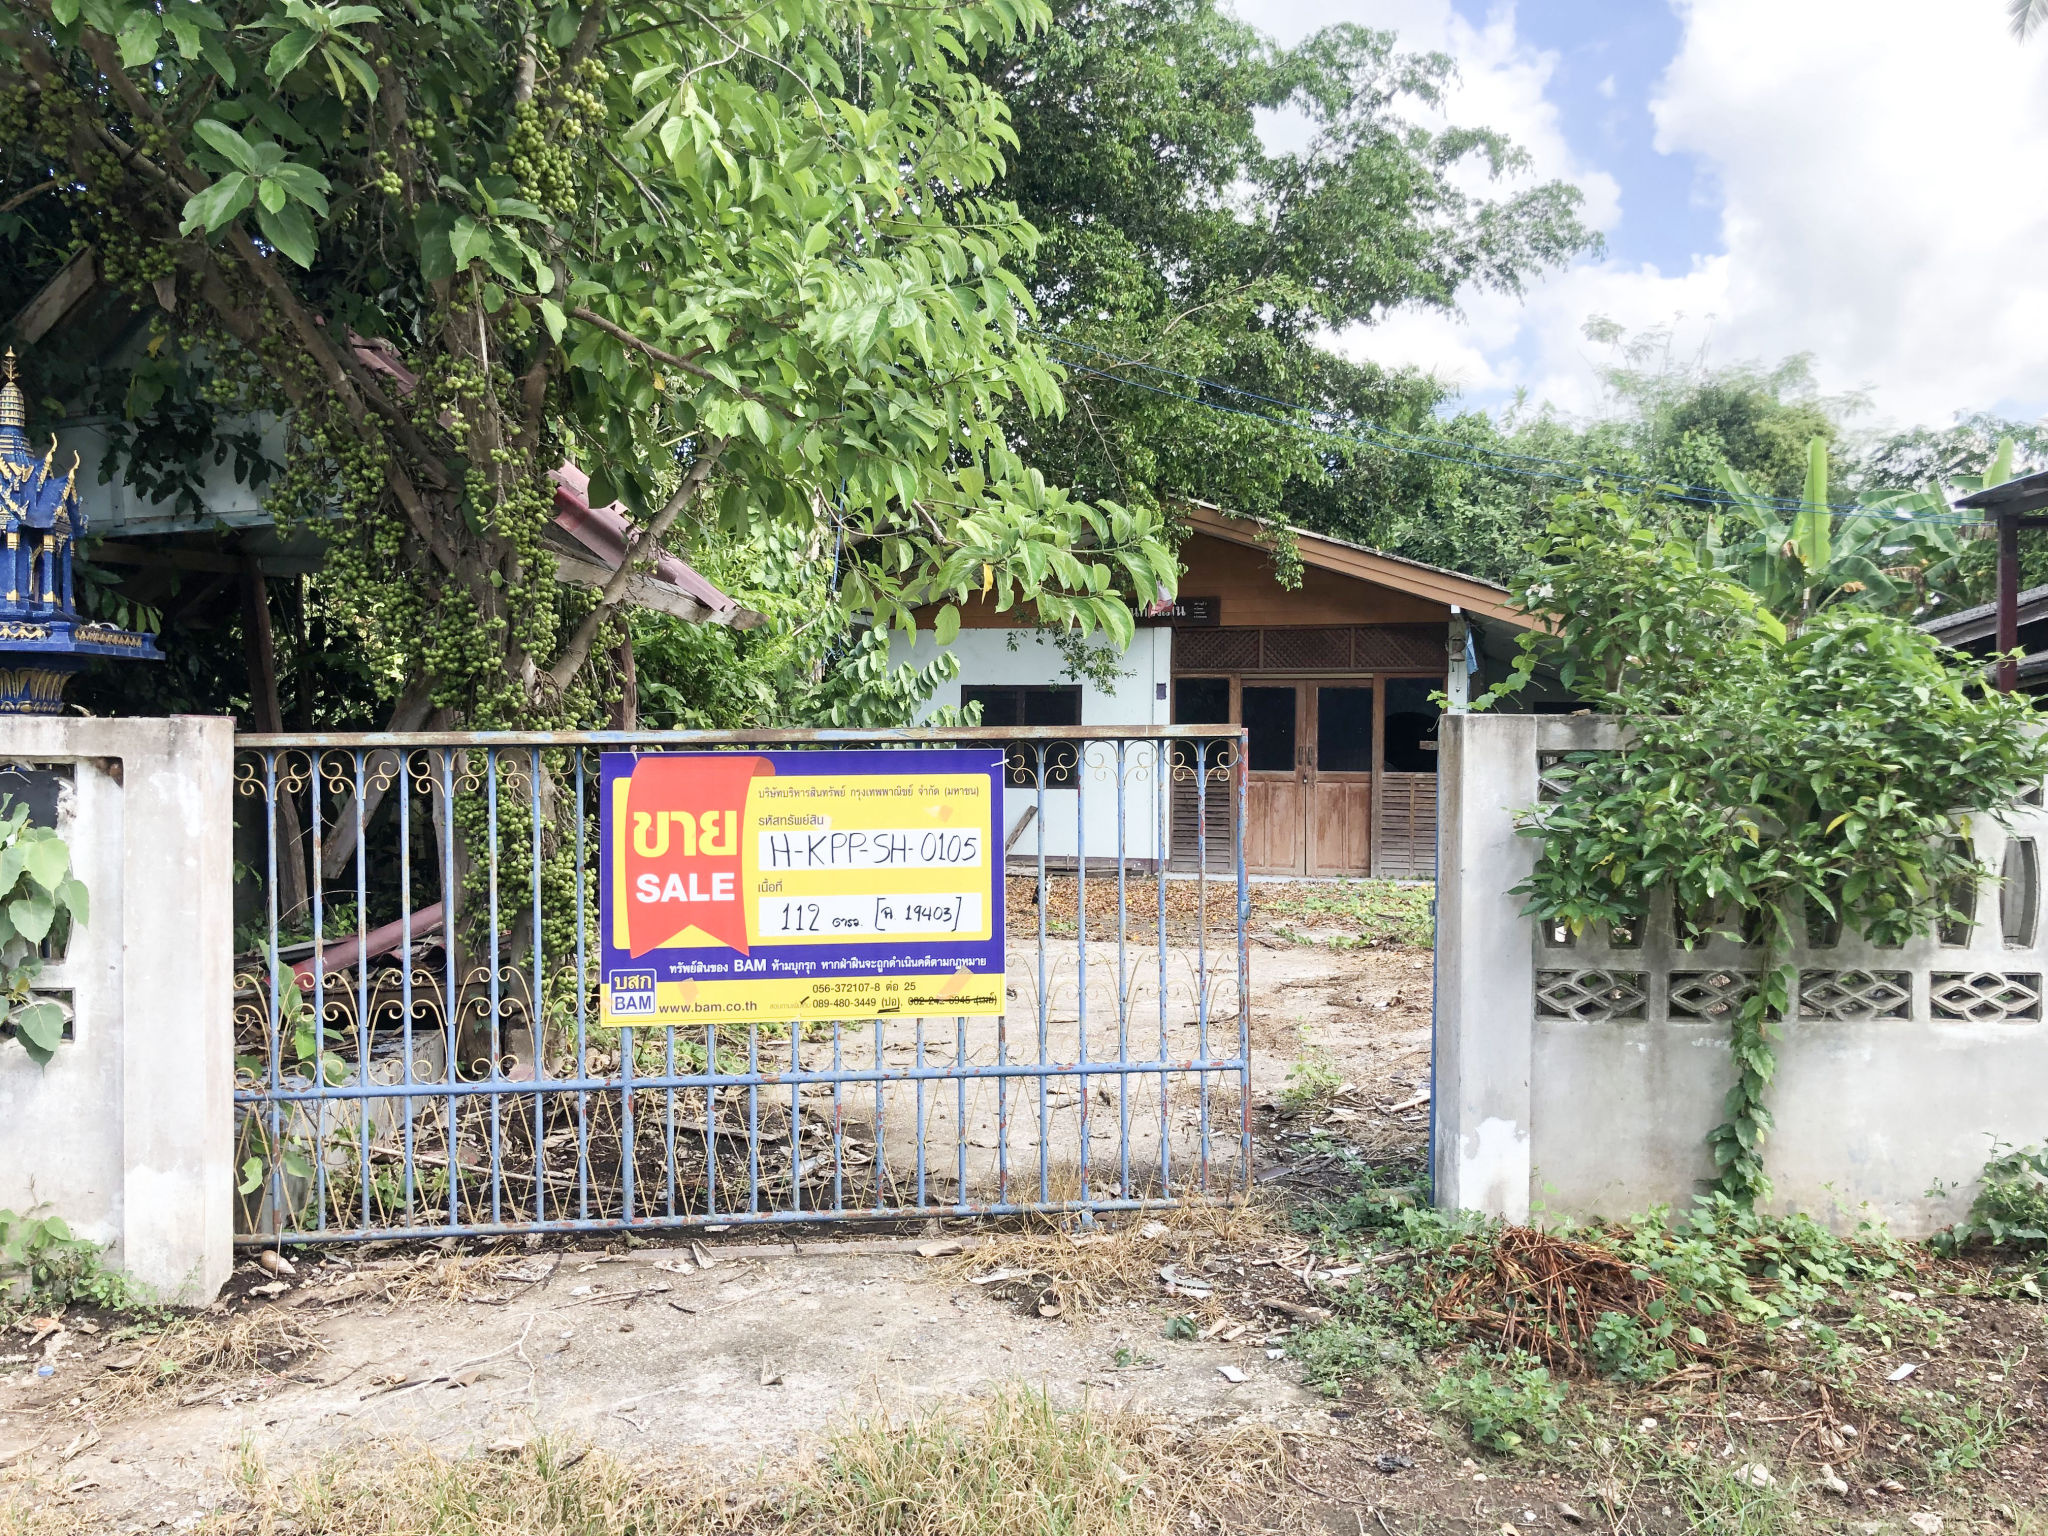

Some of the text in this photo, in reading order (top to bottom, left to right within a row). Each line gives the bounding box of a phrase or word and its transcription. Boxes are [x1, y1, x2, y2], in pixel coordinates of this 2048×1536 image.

[758, 784, 979, 801] บริษัทบริหารสินทรัพย์ กรุงเทพพาณิชย์ จำกัด (มหาชน)
[758, 813, 824, 827] รหัสทรัพย์สิน
[633, 810, 737, 858] ขาย
[635, 872, 736, 904] SALE
[757, 878, 783, 893] เนื้อที่
[781, 903, 820, 931] 112
[669, 961, 729, 975] ทรัพย์สินของ
[733, 959, 767, 973] BAM
[771, 959, 817, 976] ห้ามบุกรุก
[614, 974, 652, 991] บสก
[812, 981, 916, 994] 056-372107-8 ต่อ 25
[614, 995, 652, 1011] BAM
[659, 1001, 758, 1014] www.bam.co.th
[812, 997, 877, 1009] 089-480-3449
